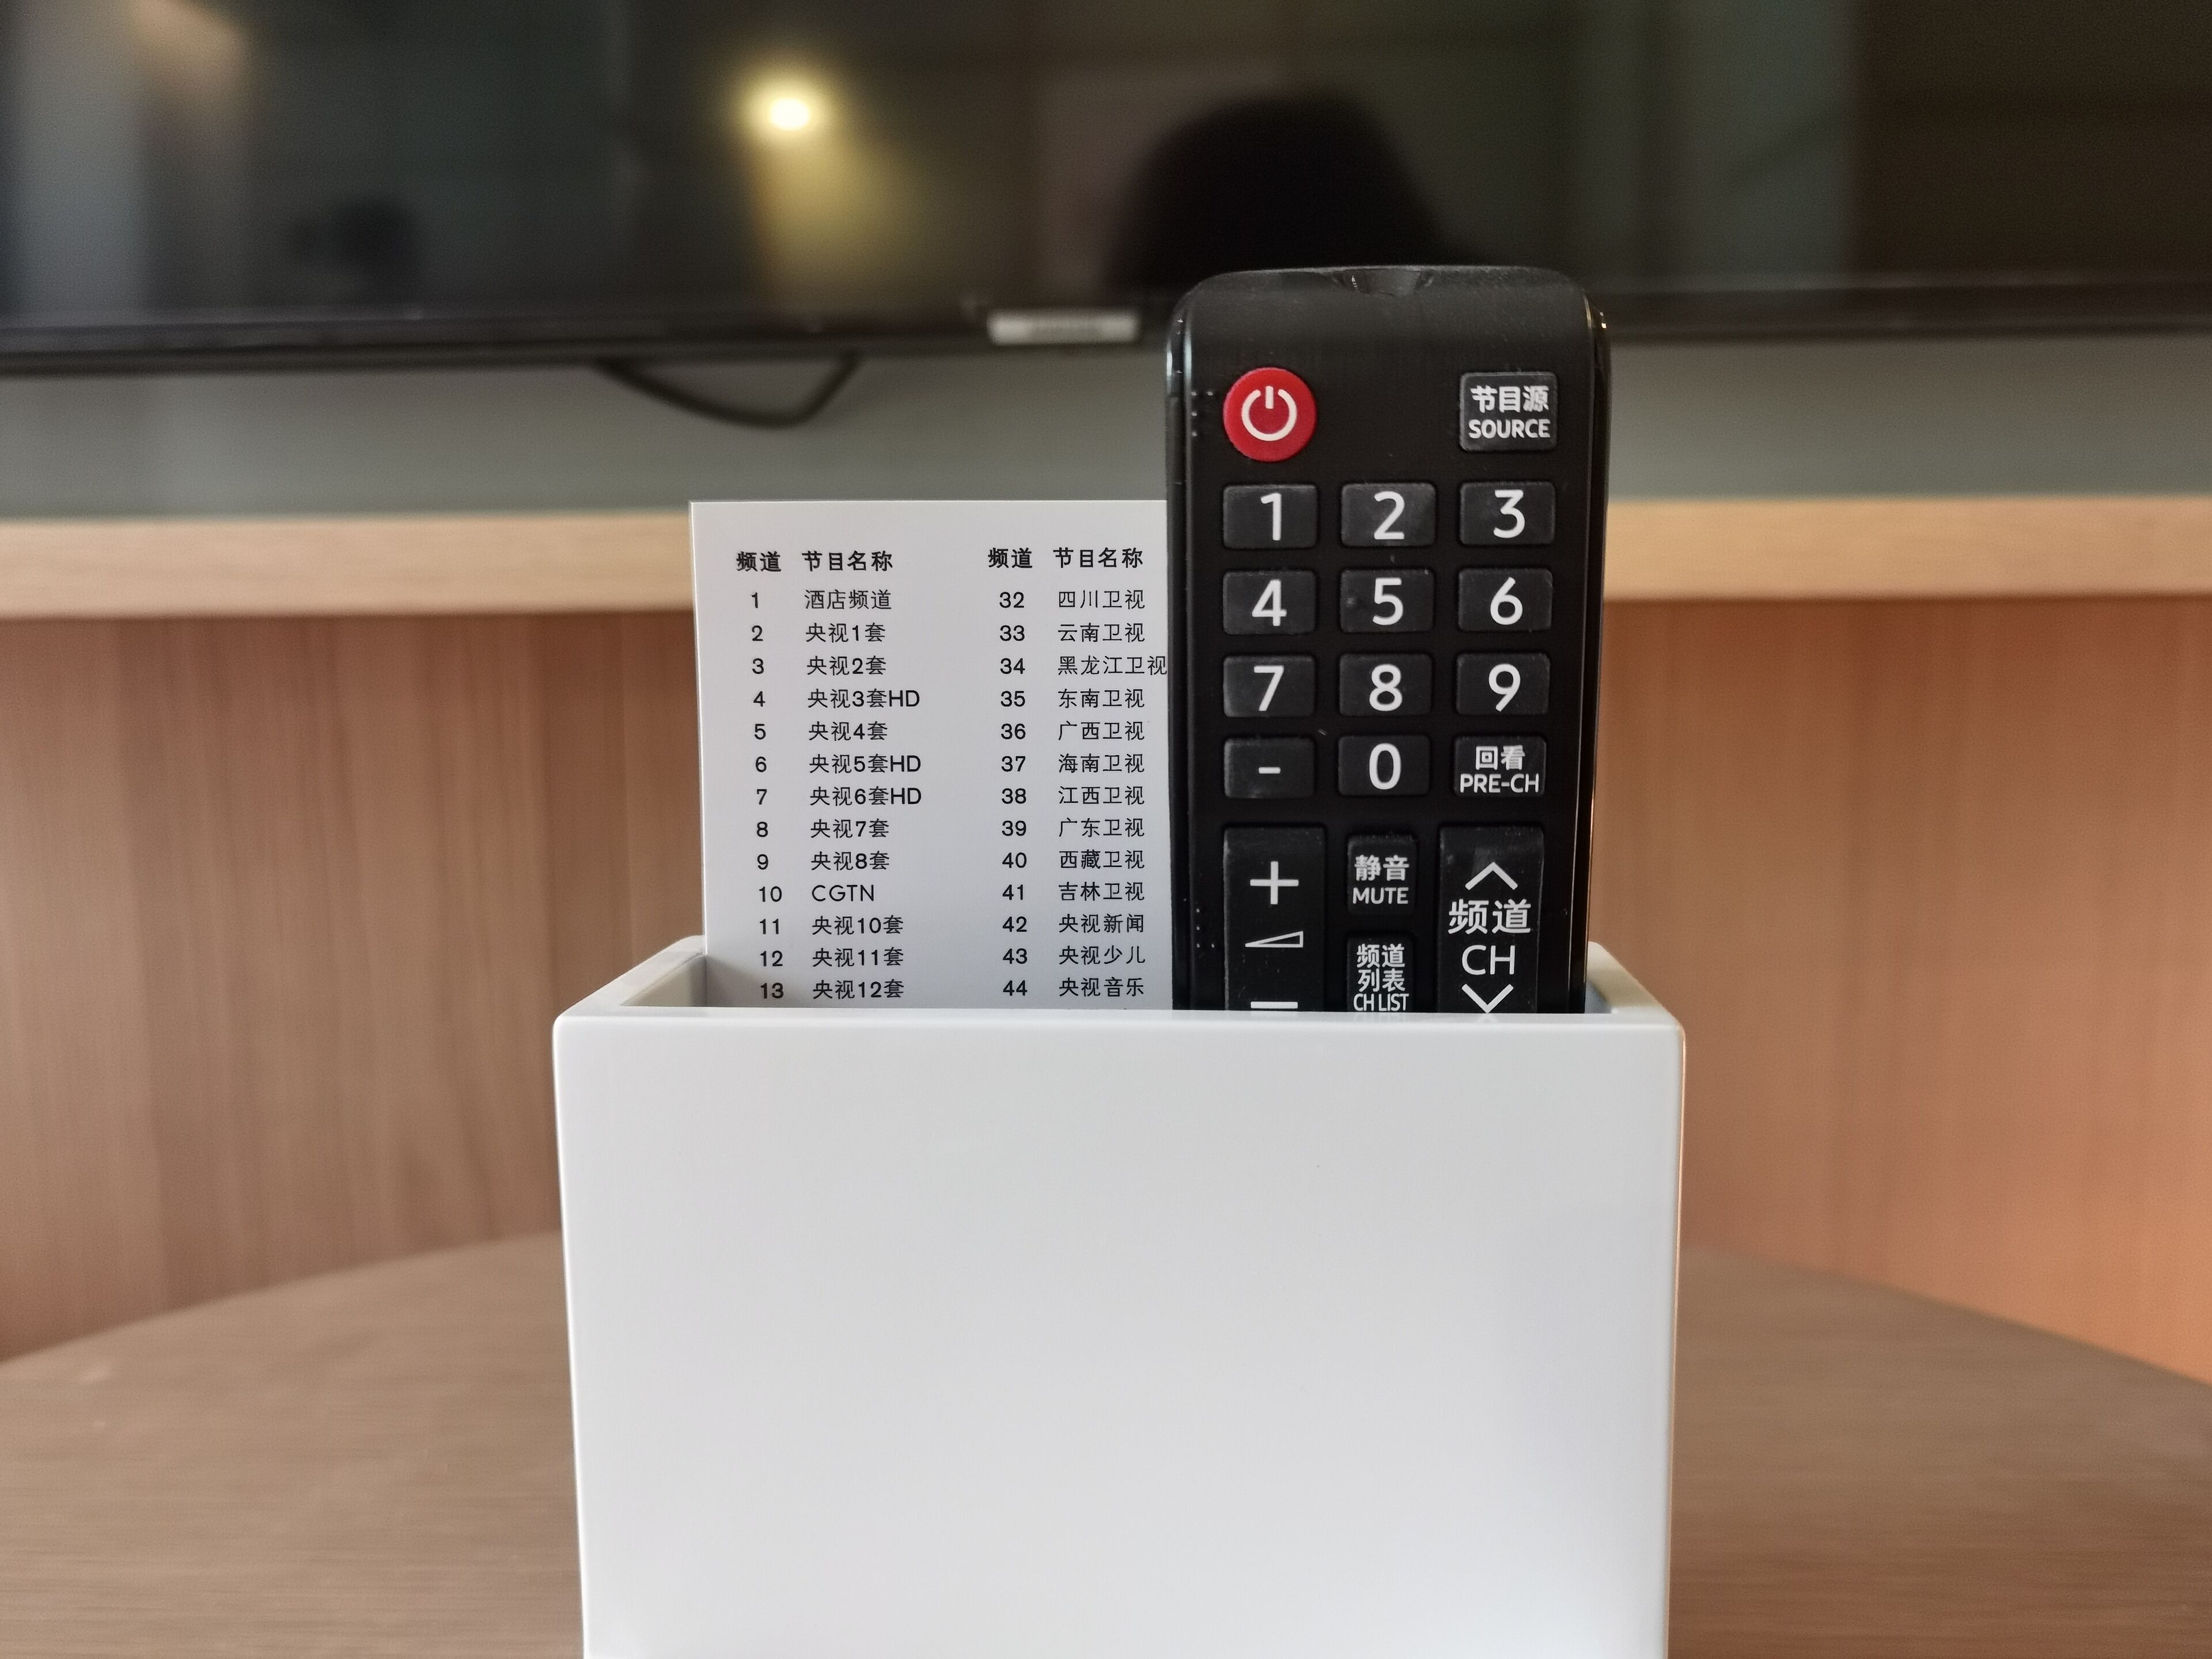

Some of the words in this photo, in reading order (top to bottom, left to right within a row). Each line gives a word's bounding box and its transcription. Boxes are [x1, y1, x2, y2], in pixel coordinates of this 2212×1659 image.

[1470, 385, 1549, 413] 节目源
[1468, 418, 1551, 439] SOURCE
[1260, 492, 1282, 541] 1
[1373, 490, 1405, 540] 2
[1493, 489, 1525, 539] 3
[736, 550, 782, 573] 频道
[801, 550, 893, 572] 节目名称
[987, 547, 1033, 569] 频道
[1052, 547, 1143, 569] 节目名称
[751, 592, 759, 609] 1
[804, 589, 892, 610] 酒店频道
[999, 591, 1025, 609] 32
[1058, 589, 1145, 610] 四川卫视
[1252, 579, 1287, 627] 4
[1372, 577, 1403, 626] 5
[1490, 577, 1523, 625] 6
[751, 624, 764, 642] 2
[805, 622, 886, 643] 央视1套
[999, 624, 1025, 642] 33
[1058, 622, 1145, 643] 云南卫视
[752, 657, 764, 675] 3
[806, 655, 887, 676] 央视2套
[999, 657, 1026, 675] 34
[1058, 655, 1167, 676] 黑龙江卫视
[753, 691, 766, 707] 4
[807, 688, 920, 709] 央视3套HD
[1000, 690, 1026, 707] 35
[1058, 688, 1145, 709] 东南卫视
[1253, 665, 1285, 711] 7
[1369, 664, 1403, 711] 8
[1488, 664, 1521, 712] 9
[753, 723, 766, 740] 5
[808, 721, 888, 742] 央视4套
[1000, 723, 1027, 740] 36
[1058, 720, 1145, 741] 广西卫视
[755, 756, 767, 773] 6
[809, 753, 921, 774] 央视5套HD
[1001, 755, 1026, 772] 37
[1058, 753, 1145, 774] 海南卫视
[1369, 743, 1401, 790] 0
[1475, 745, 1525, 770] 回看
[1460, 773, 1539, 793] PRE-CH
[756, 788, 768, 805] 7
[809, 785, 922, 807] 央视6套HD
[1001, 787, 1027, 805] 38
[1058, 785, 1145, 806] 江西卫视
[756, 821, 769, 838] 8
[810, 817, 889, 839] 央视7套
[1001, 820, 1027, 837] 39
[1058, 817, 1145, 838] 广东卫视
[756, 853, 769, 870] 9
[810, 850, 890, 872] 央视8套
[1002, 851, 1027, 869] 40
[1059, 849, 1145, 870] 西藏卫视
[1354, 854, 1409, 881] 静音
[759, 885, 782, 903] 10
[811, 884, 874, 902] CGTN
[1002, 884, 1024, 901] 41
[1058, 881, 1145, 902] 吉林卫视
[1353, 887, 1408, 904] MUTE
[759, 918, 779, 935] 11
[812, 914, 904, 936] 央视10套
[1002, 916, 1028, 933] 42
[1058, 912, 1144, 934] 央视新闻
[1448, 899, 1531, 934] 频道
[760, 950, 783, 967] 12
[812, 946, 904, 968] 央视11套
[1002, 948, 1028, 965] 43
[1058, 945, 1146, 965] 央视少儿
[1356, 943, 1405, 968] 频道
[1461, 945, 1516, 975] CH
[760, 982, 784, 999] 13
[812, 978, 904, 1000] 央视12套
[1002, 979, 1028, 997] 44
[1059, 976, 1144, 997] 央视音乐
[1358, 968, 1406, 992] 列表
[1353, 993, 1374, 1012] CH
[1378, 993, 1410, 1012] LIST
